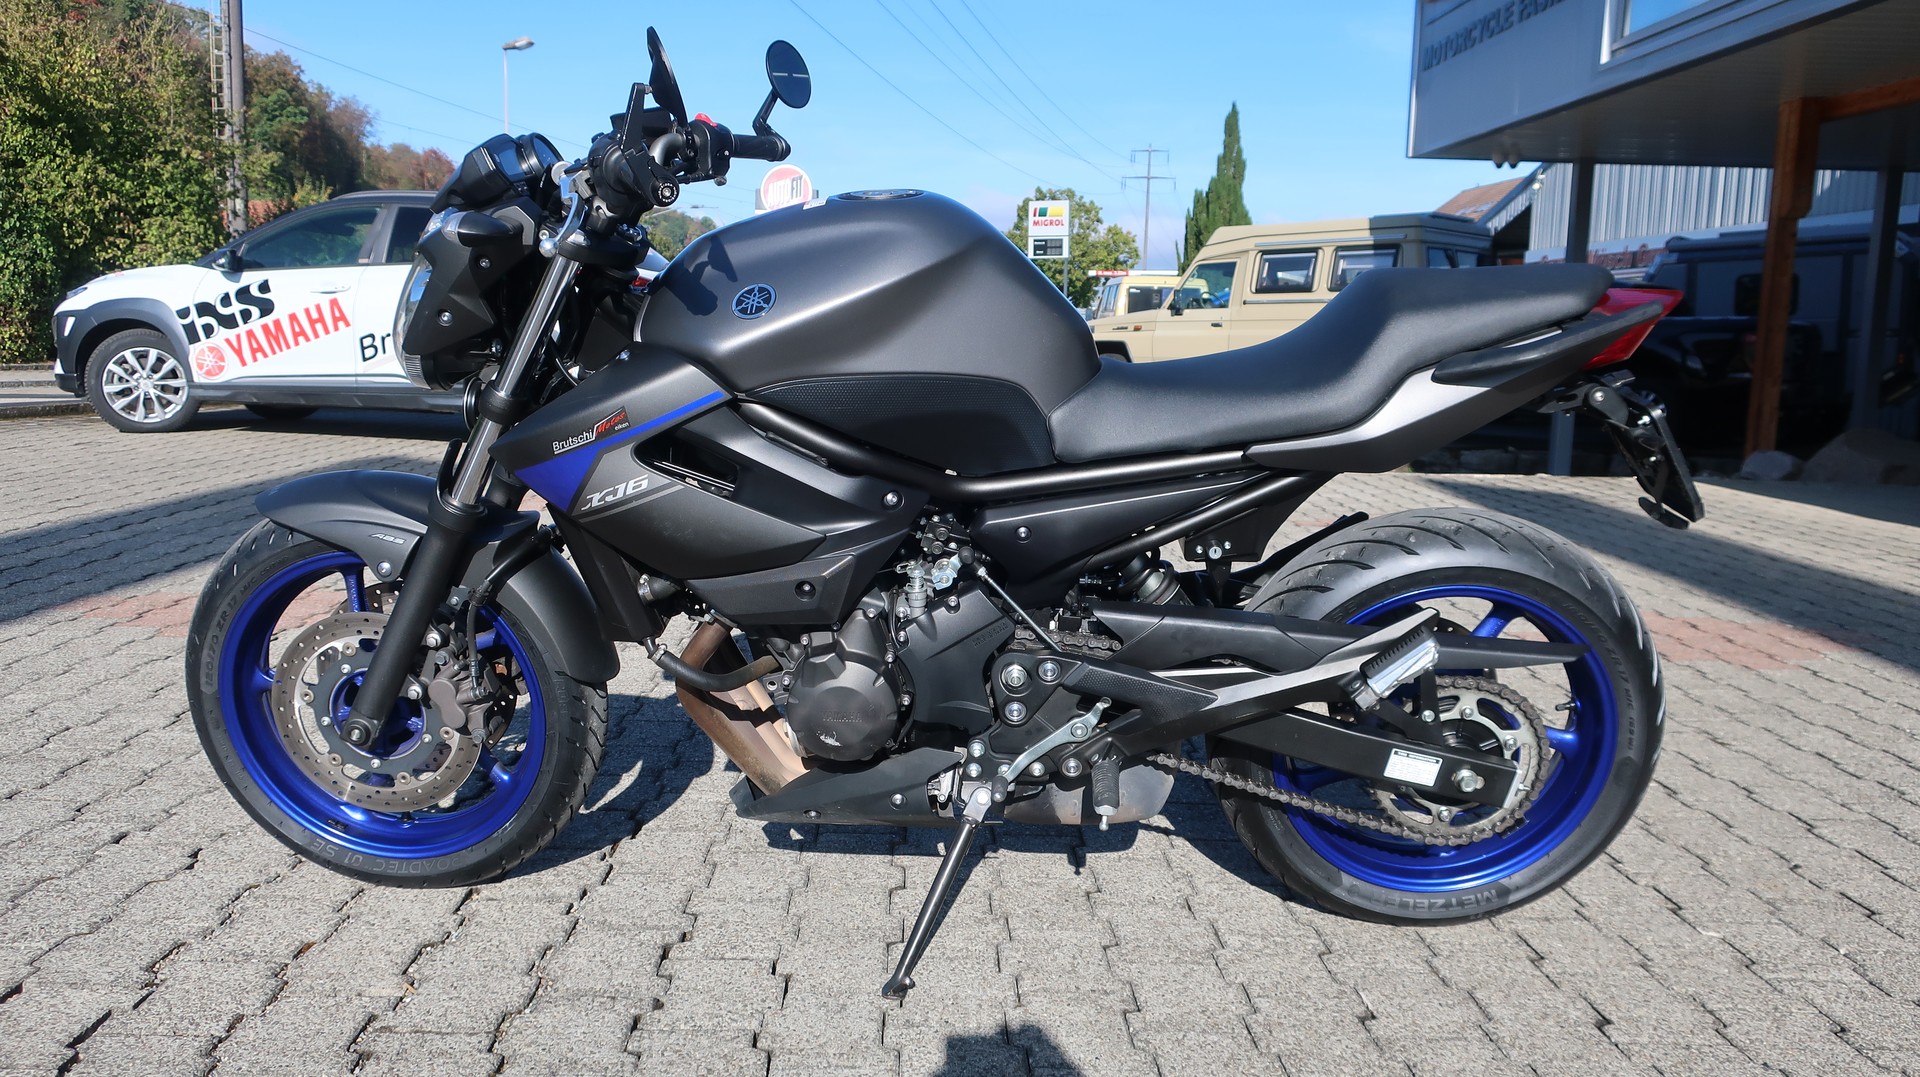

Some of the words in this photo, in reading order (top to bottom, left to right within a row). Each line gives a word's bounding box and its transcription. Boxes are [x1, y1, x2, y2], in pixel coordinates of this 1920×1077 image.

[1032, 219, 1065, 227] MIGROL
[224, 297, 351, 368] YAMAHA
[359, 332, 392, 363] Br
[552, 429, 593, 452] Brutschi
[595, 411, 626, 437] Motos
[614, 421, 630, 431] eiken
[581, 474, 649, 511] XJ6
[369, 533, 406, 545] ABS
[310, 838, 339, 858] SE
